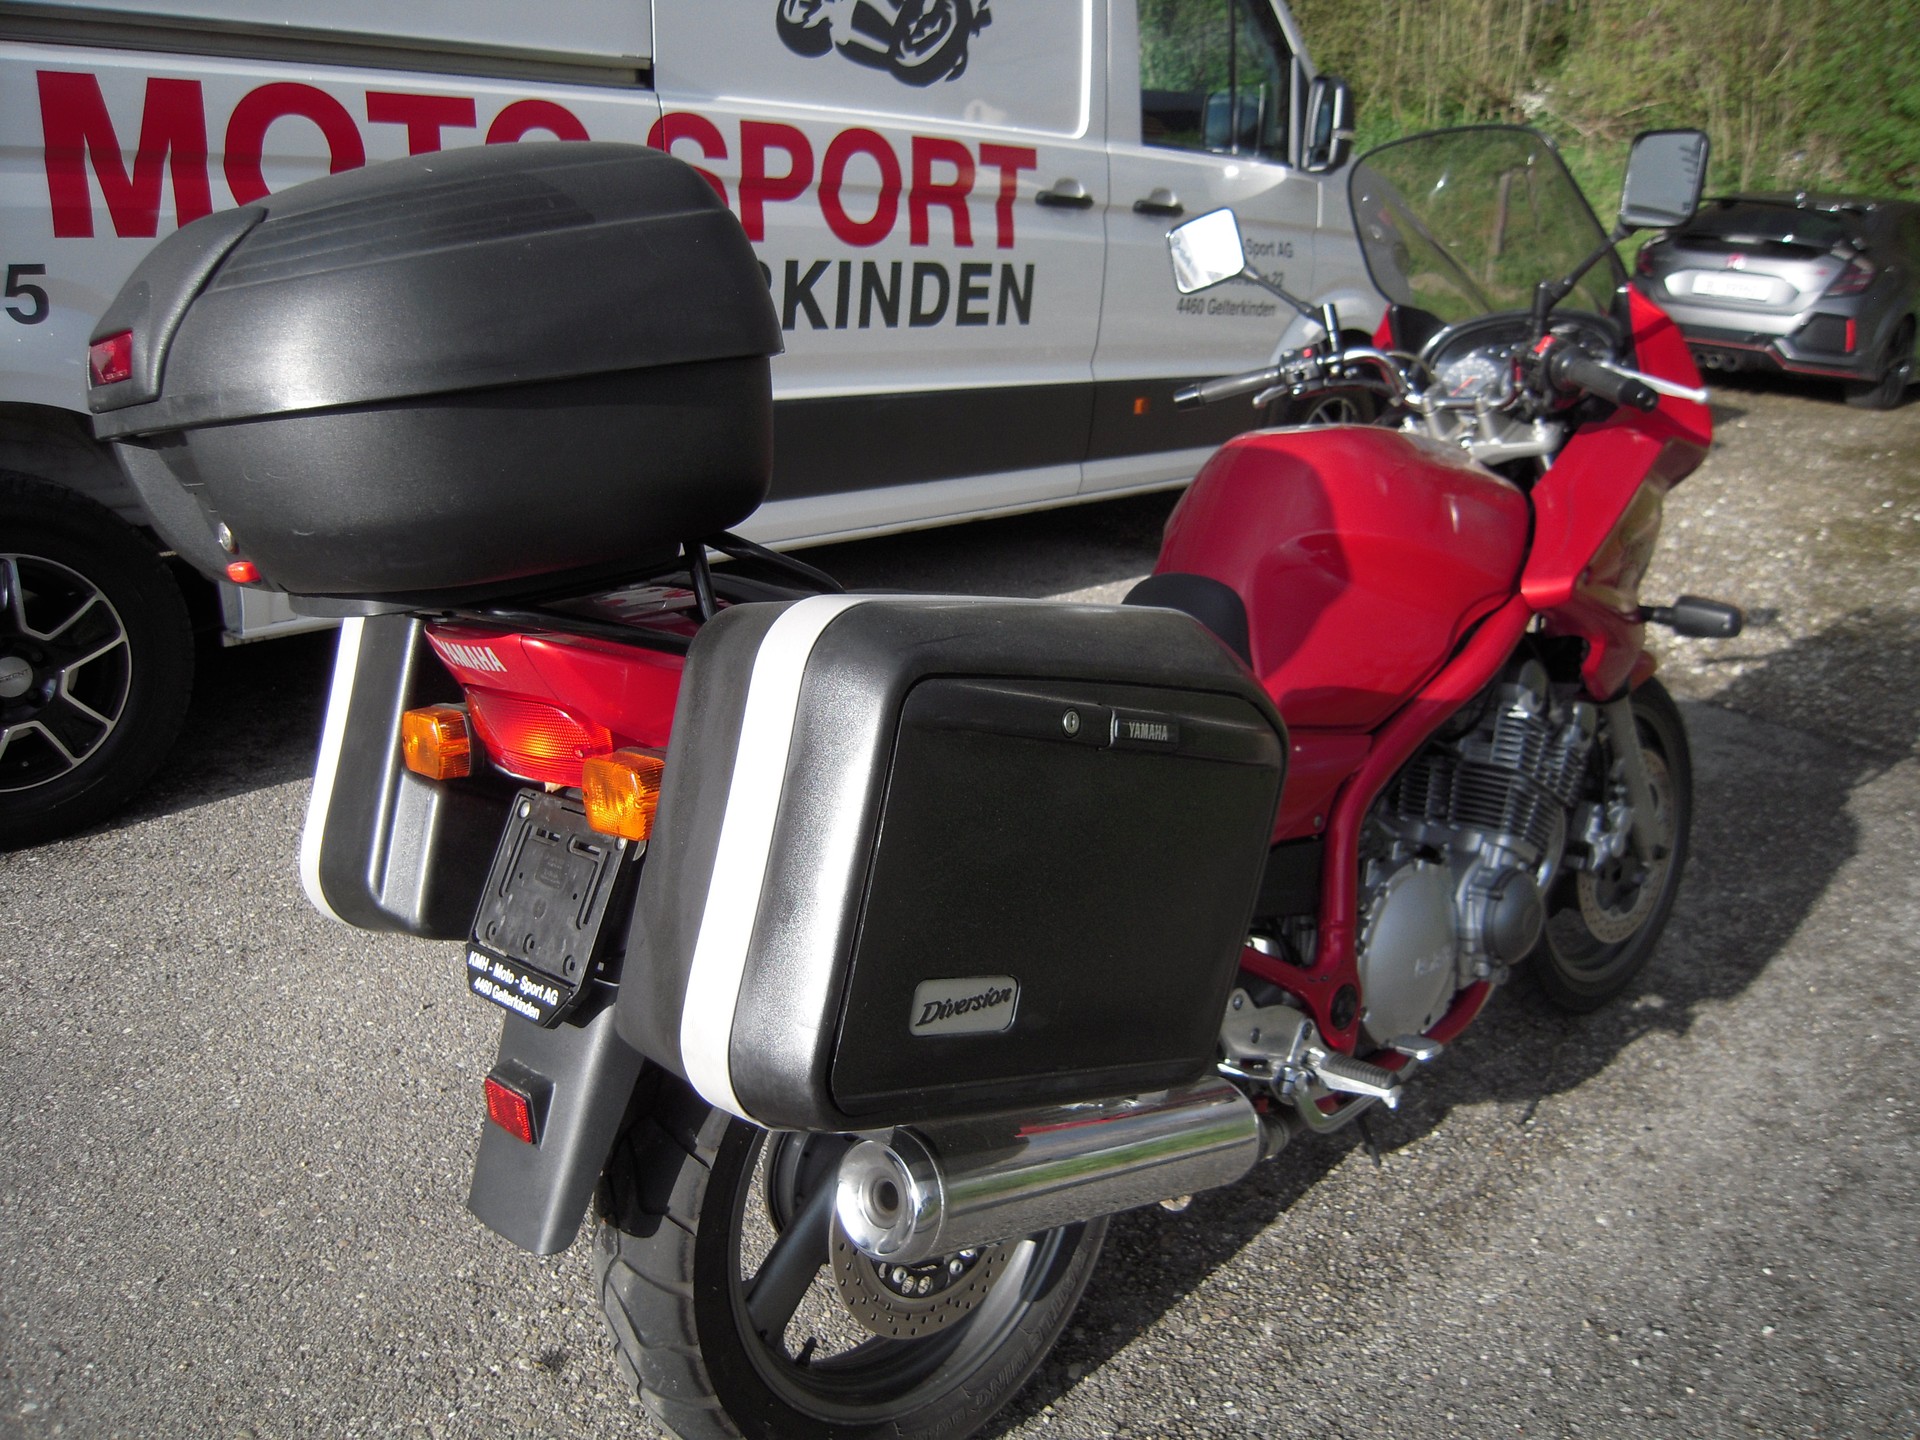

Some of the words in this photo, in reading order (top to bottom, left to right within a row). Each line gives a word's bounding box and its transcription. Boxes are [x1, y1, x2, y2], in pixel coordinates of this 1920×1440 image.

[36, 69, 591, 238] MOT
[4, 263, 50, 325] 5
[756, 259, 1035, 331] KINDEN
[437, 638, 509, 673] YAMAHA
[1128, 721, 1169, 741] YAMAHA
[468, 950, 490, 972] KMH
[492, 962, 515, 985] Moto
[519, 975, 544, 999] Sport
[542, 986, 559, 1006] AG
[914, 986, 1013, 1027] Diversion
